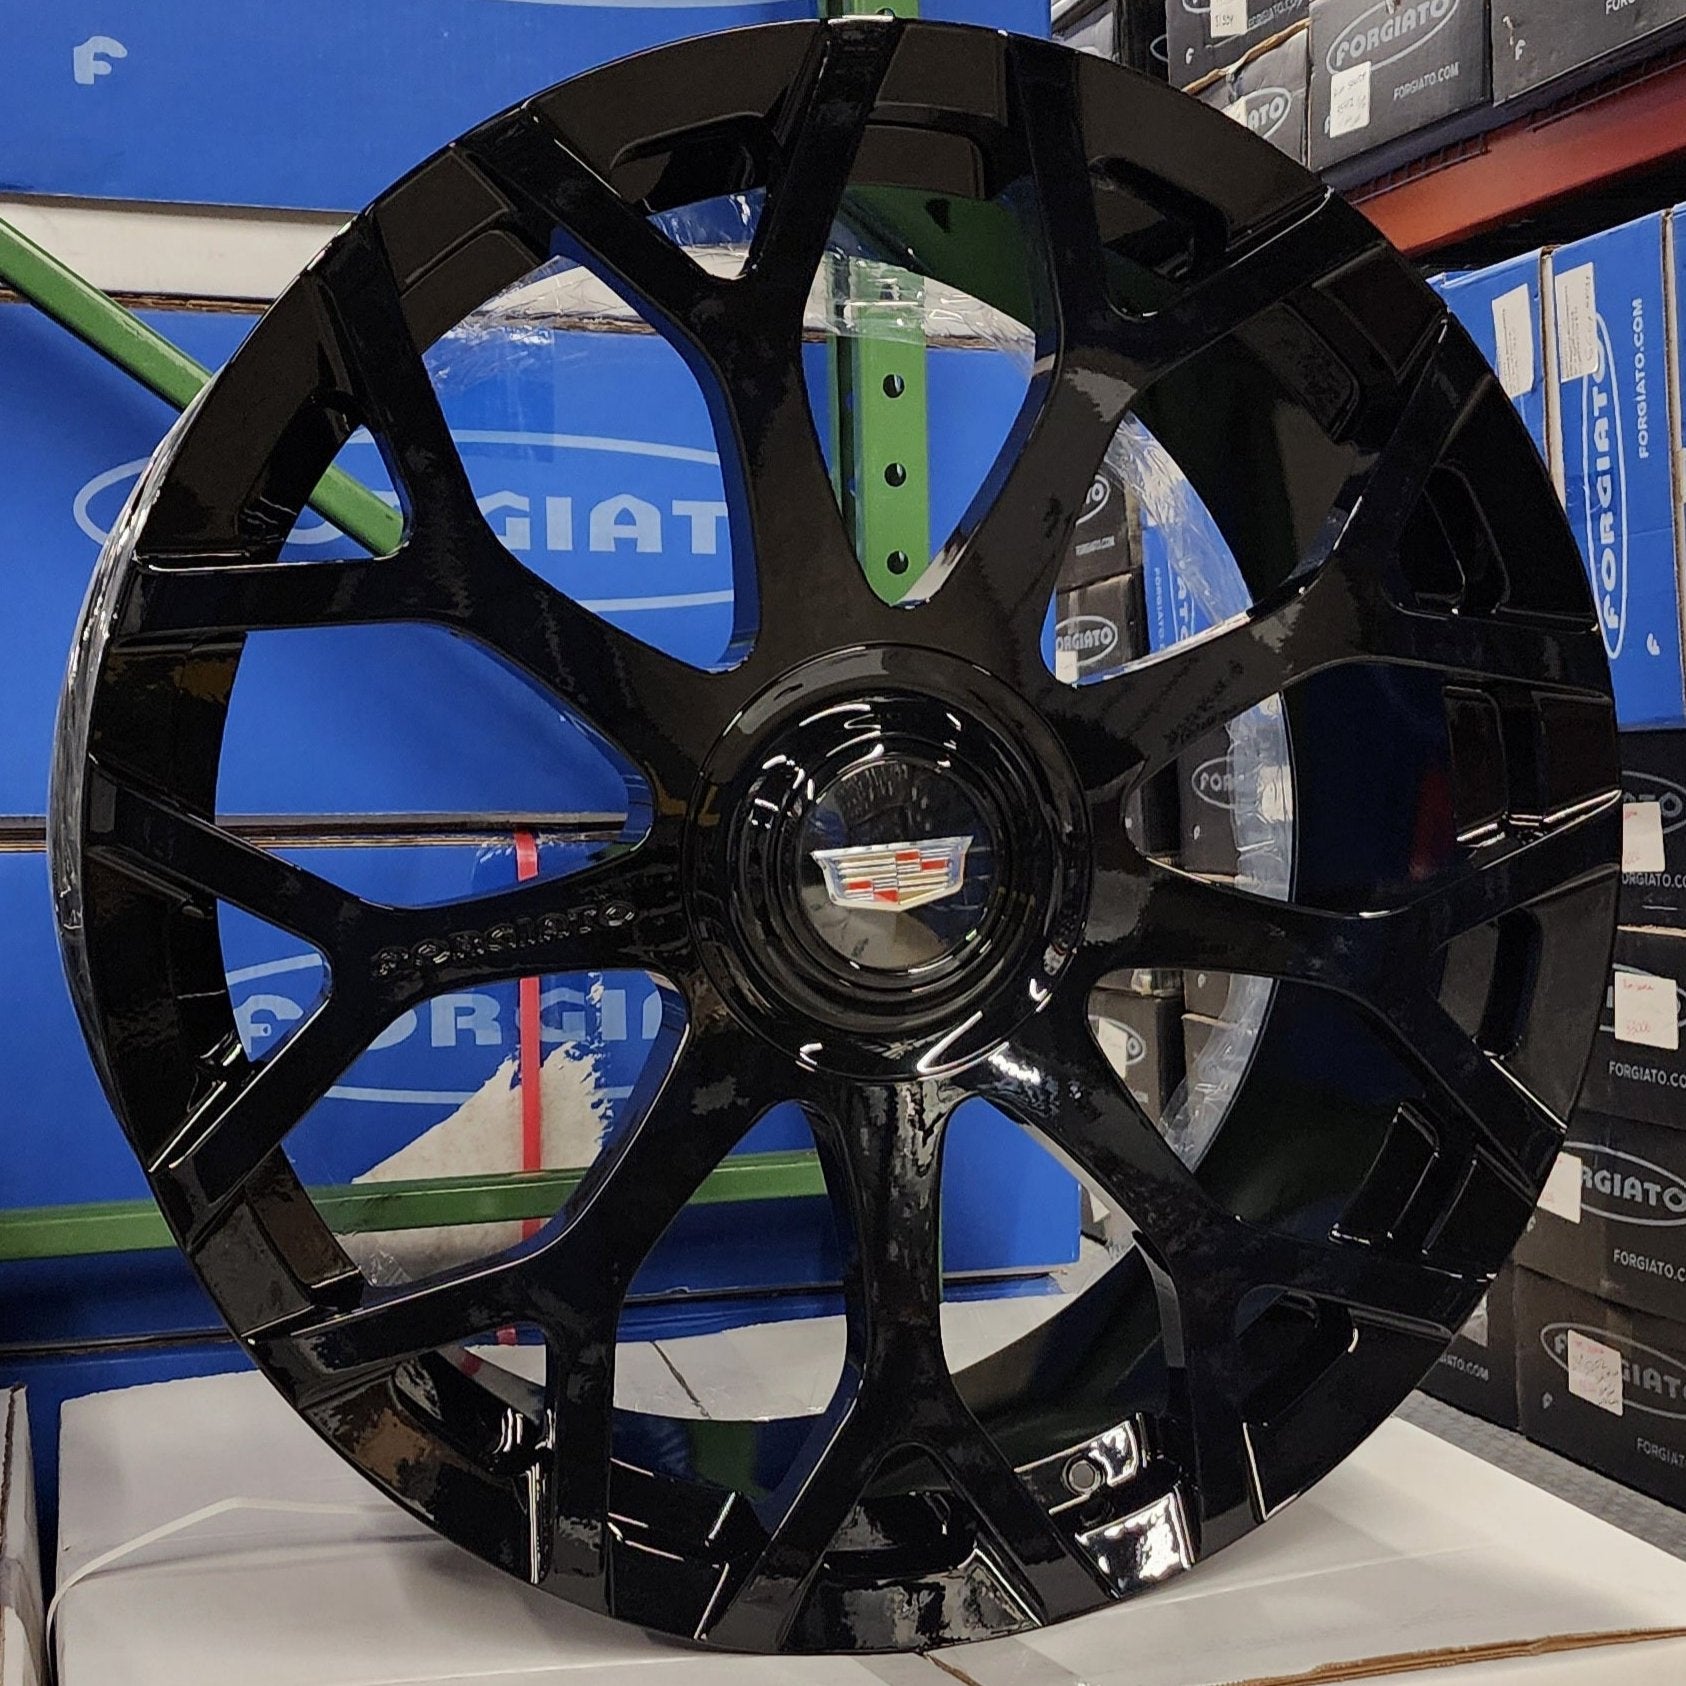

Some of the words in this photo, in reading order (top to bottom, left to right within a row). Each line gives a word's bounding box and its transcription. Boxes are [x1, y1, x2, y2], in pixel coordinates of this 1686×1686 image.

[1336, 0, 1449, 67] FORGIATO
[1515, 39, 1526, 61] F
[73, 35, 128, 85] F
[1393, 61, 1460, 101] FORGIATO.COM
[1631, 297, 1651, 460] FORGIATO.COM
[1591, 338, 1620, 629] FORGIATO
[1646, 632, 1661, 656] F
